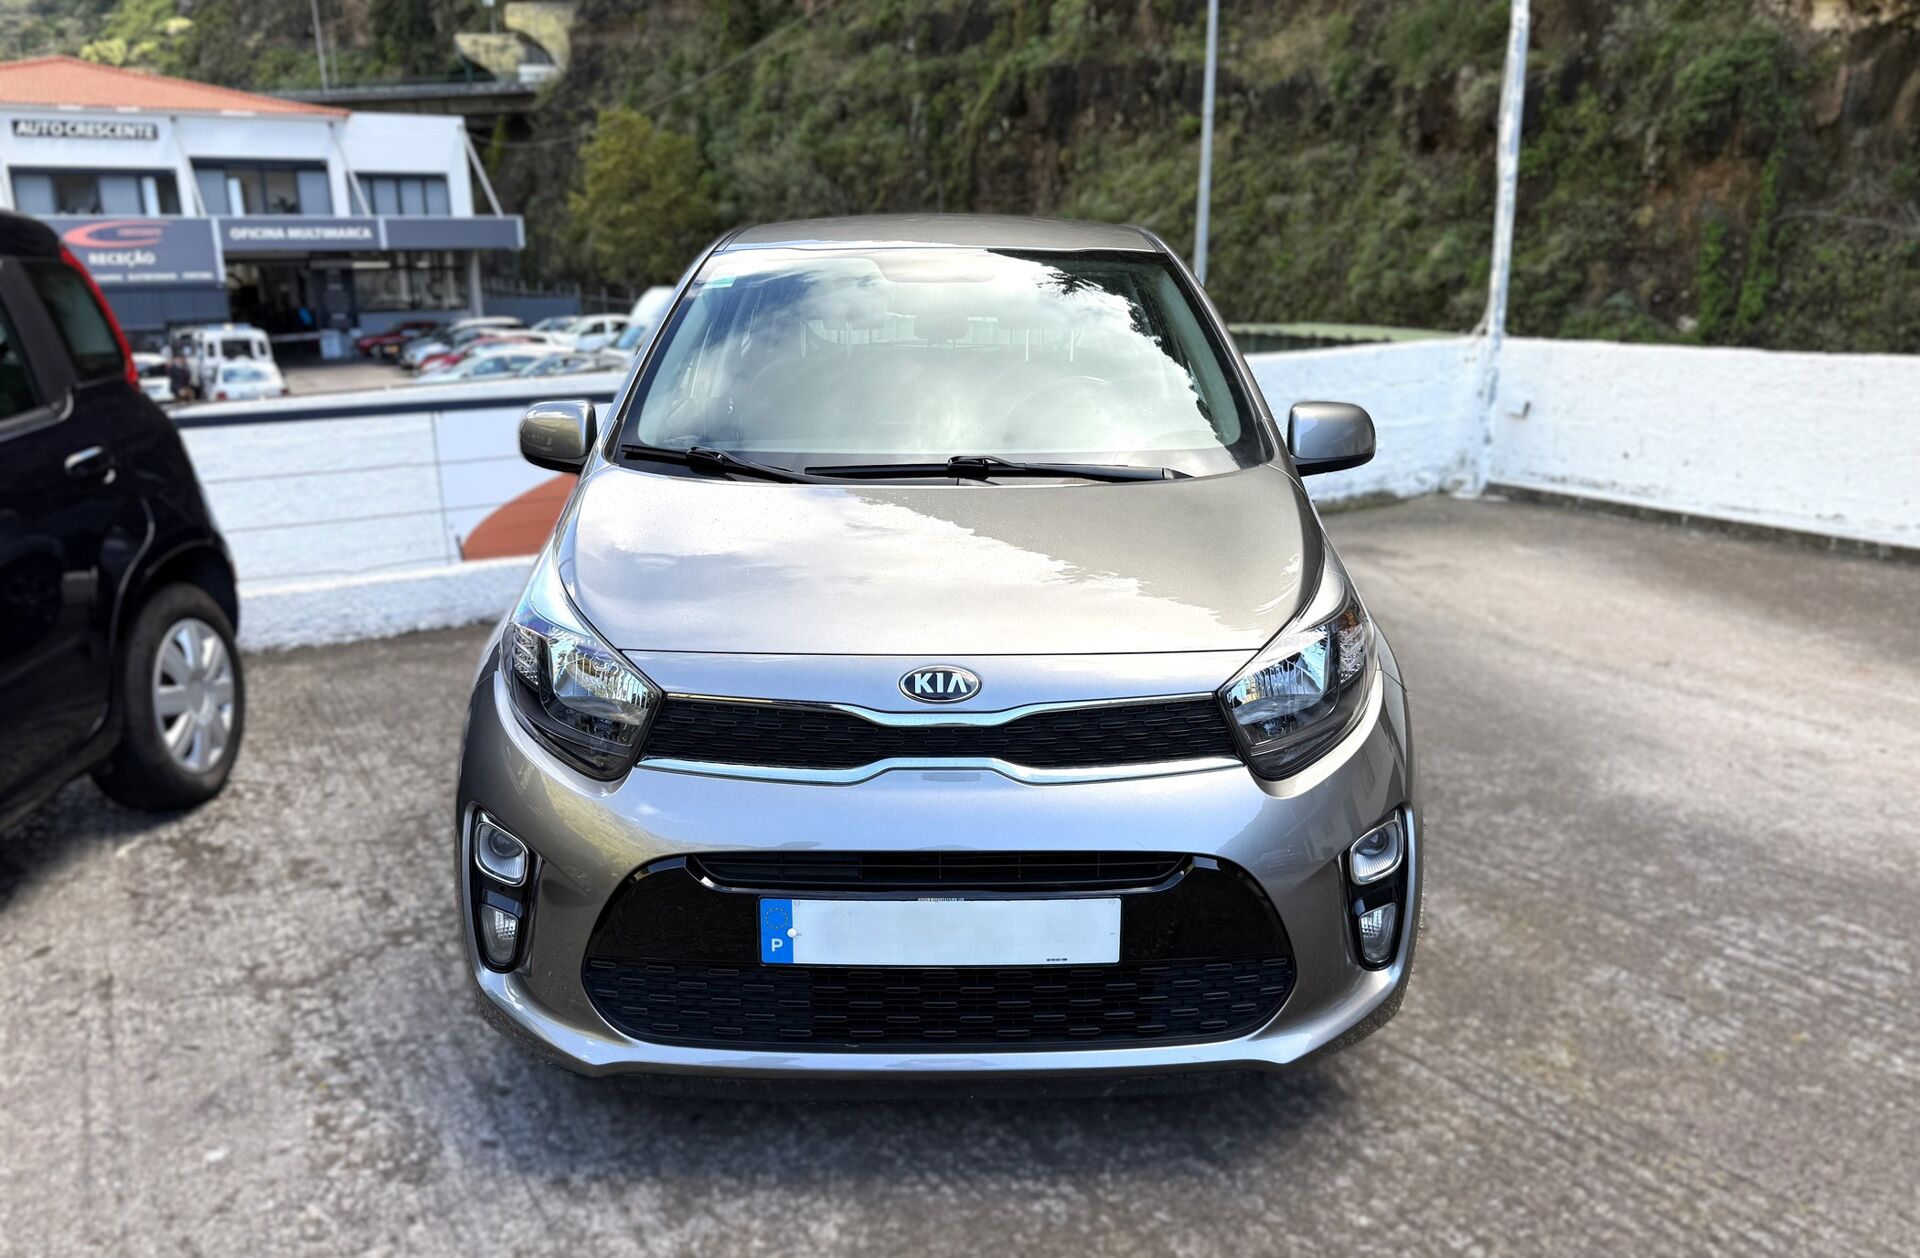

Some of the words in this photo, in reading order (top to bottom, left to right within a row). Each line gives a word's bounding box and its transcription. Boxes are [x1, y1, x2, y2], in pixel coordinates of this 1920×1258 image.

[229, 227, 285, 240] OFICINA
[287, 227, 372, 240] MULTIMARCA
[914, 672, 968, 694] KIA
[771, 938, 783, 952] P
